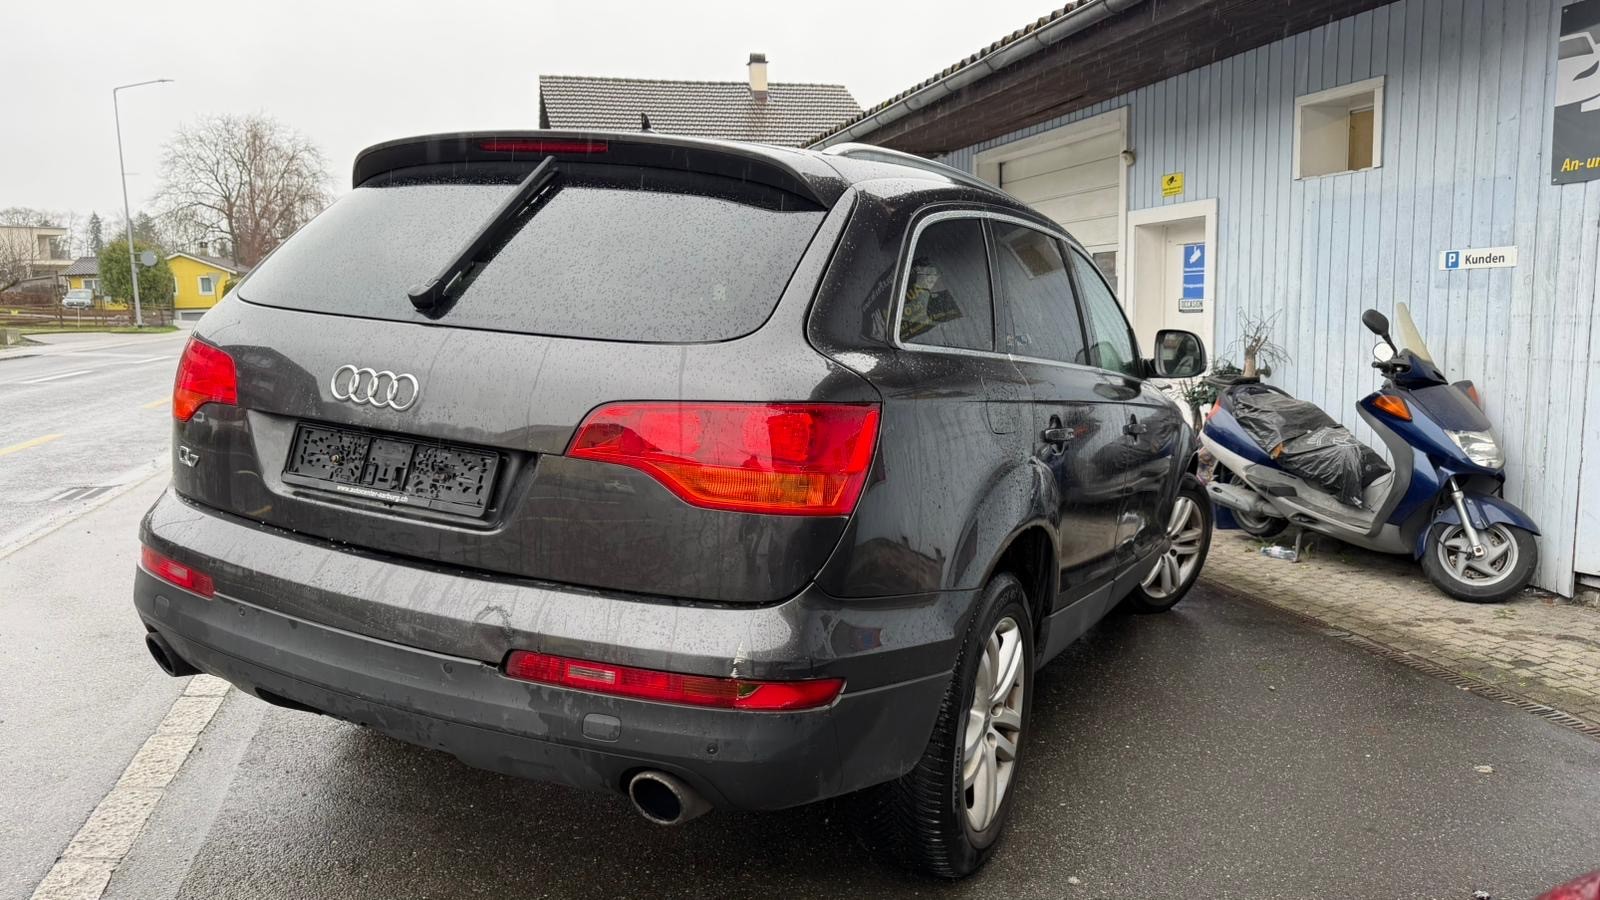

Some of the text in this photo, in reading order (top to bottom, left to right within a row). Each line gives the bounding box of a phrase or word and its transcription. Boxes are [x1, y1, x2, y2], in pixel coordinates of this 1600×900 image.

[1560, 157, 1585, 172] An-
[1448, 252, 1506, 267] P Kunden
[178, 445, 200, 467] Q7
